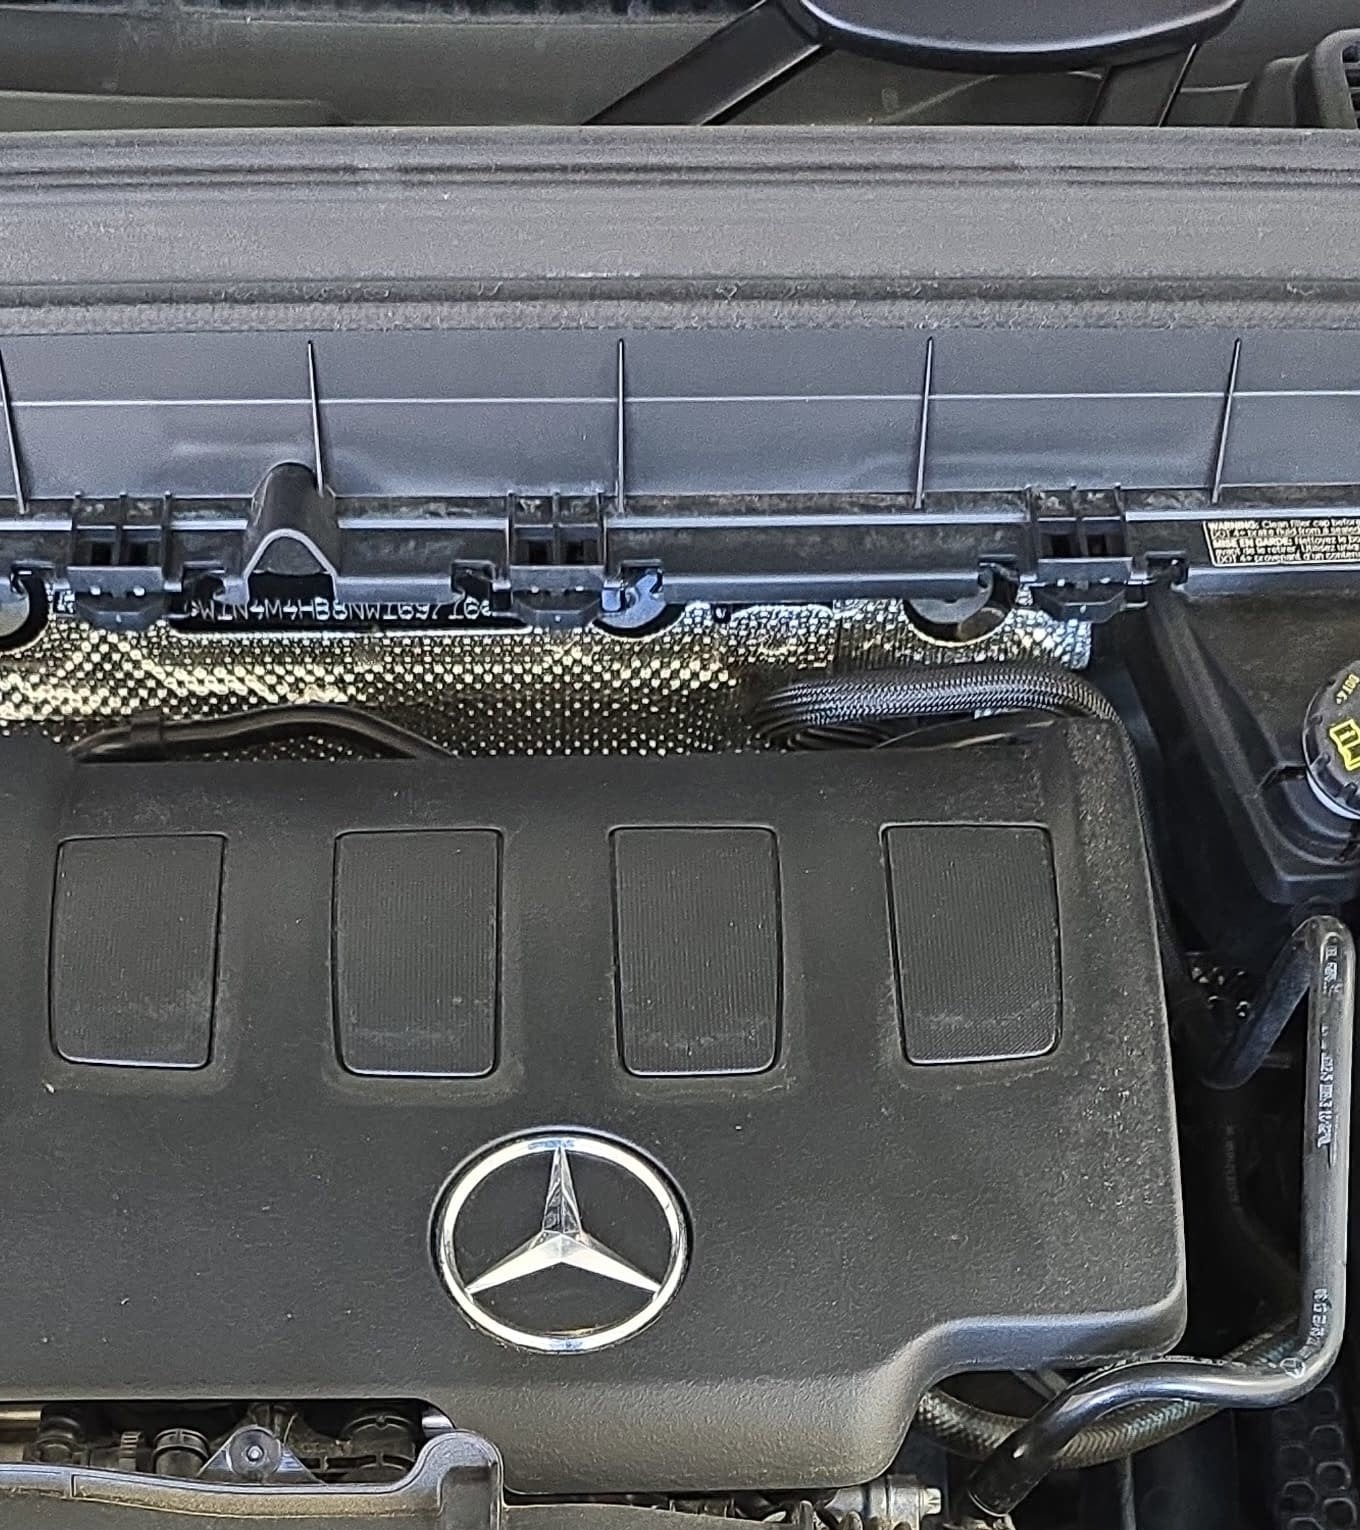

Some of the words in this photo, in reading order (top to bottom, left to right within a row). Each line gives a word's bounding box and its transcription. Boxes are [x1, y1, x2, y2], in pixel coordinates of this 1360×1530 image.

[1208, 521, 1259, 529] WARNING:
[1262, 520, 1288, 528] Clean
[1312, 519, 1330, 528] cap
[1331, 518, 1360, 527] before
[1213, 538, 1238, 548] MISE
[1239, 538, 1254, 547] EN
[1255, 537, 1293, 547] GARDE:
[1346, 674, 1360, 694] DOT
